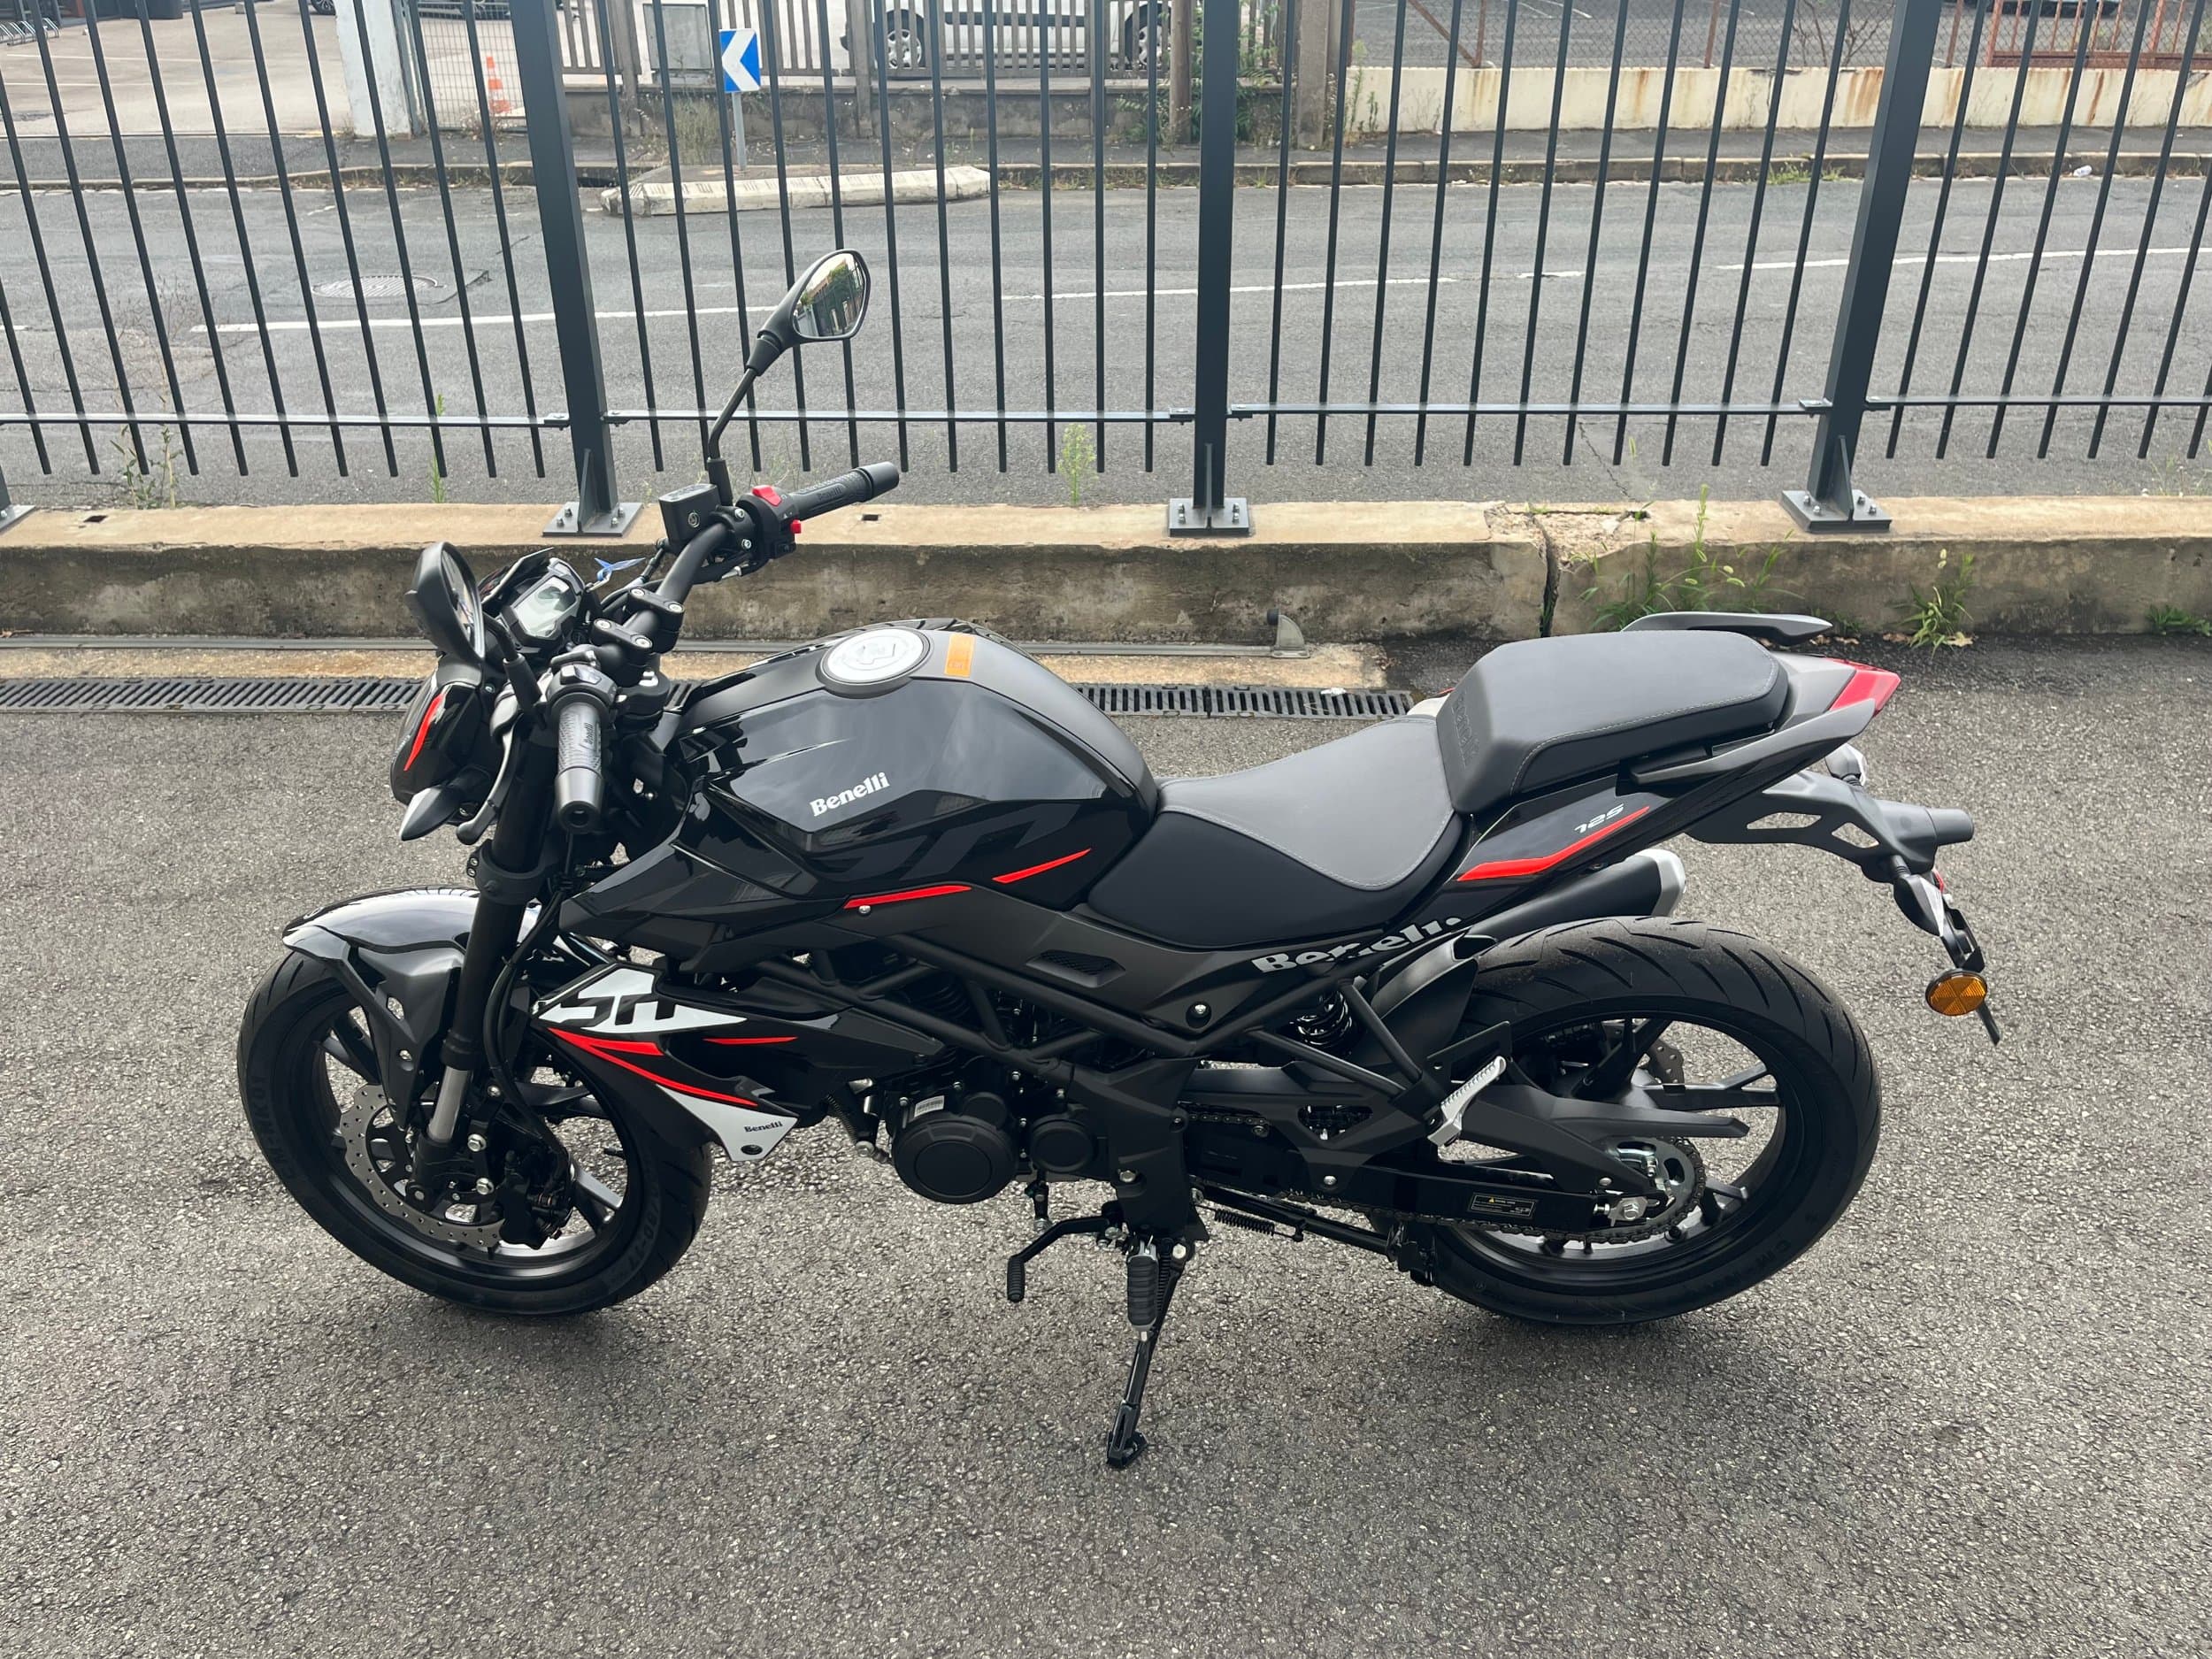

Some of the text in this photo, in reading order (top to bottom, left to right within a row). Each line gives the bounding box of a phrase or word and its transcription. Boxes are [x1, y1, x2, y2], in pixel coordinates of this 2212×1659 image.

[809, 772, 891, 818] Benelli
[1574, 803, 1624, 833] 125
[744, 1121, 783, 1133] Benelli
